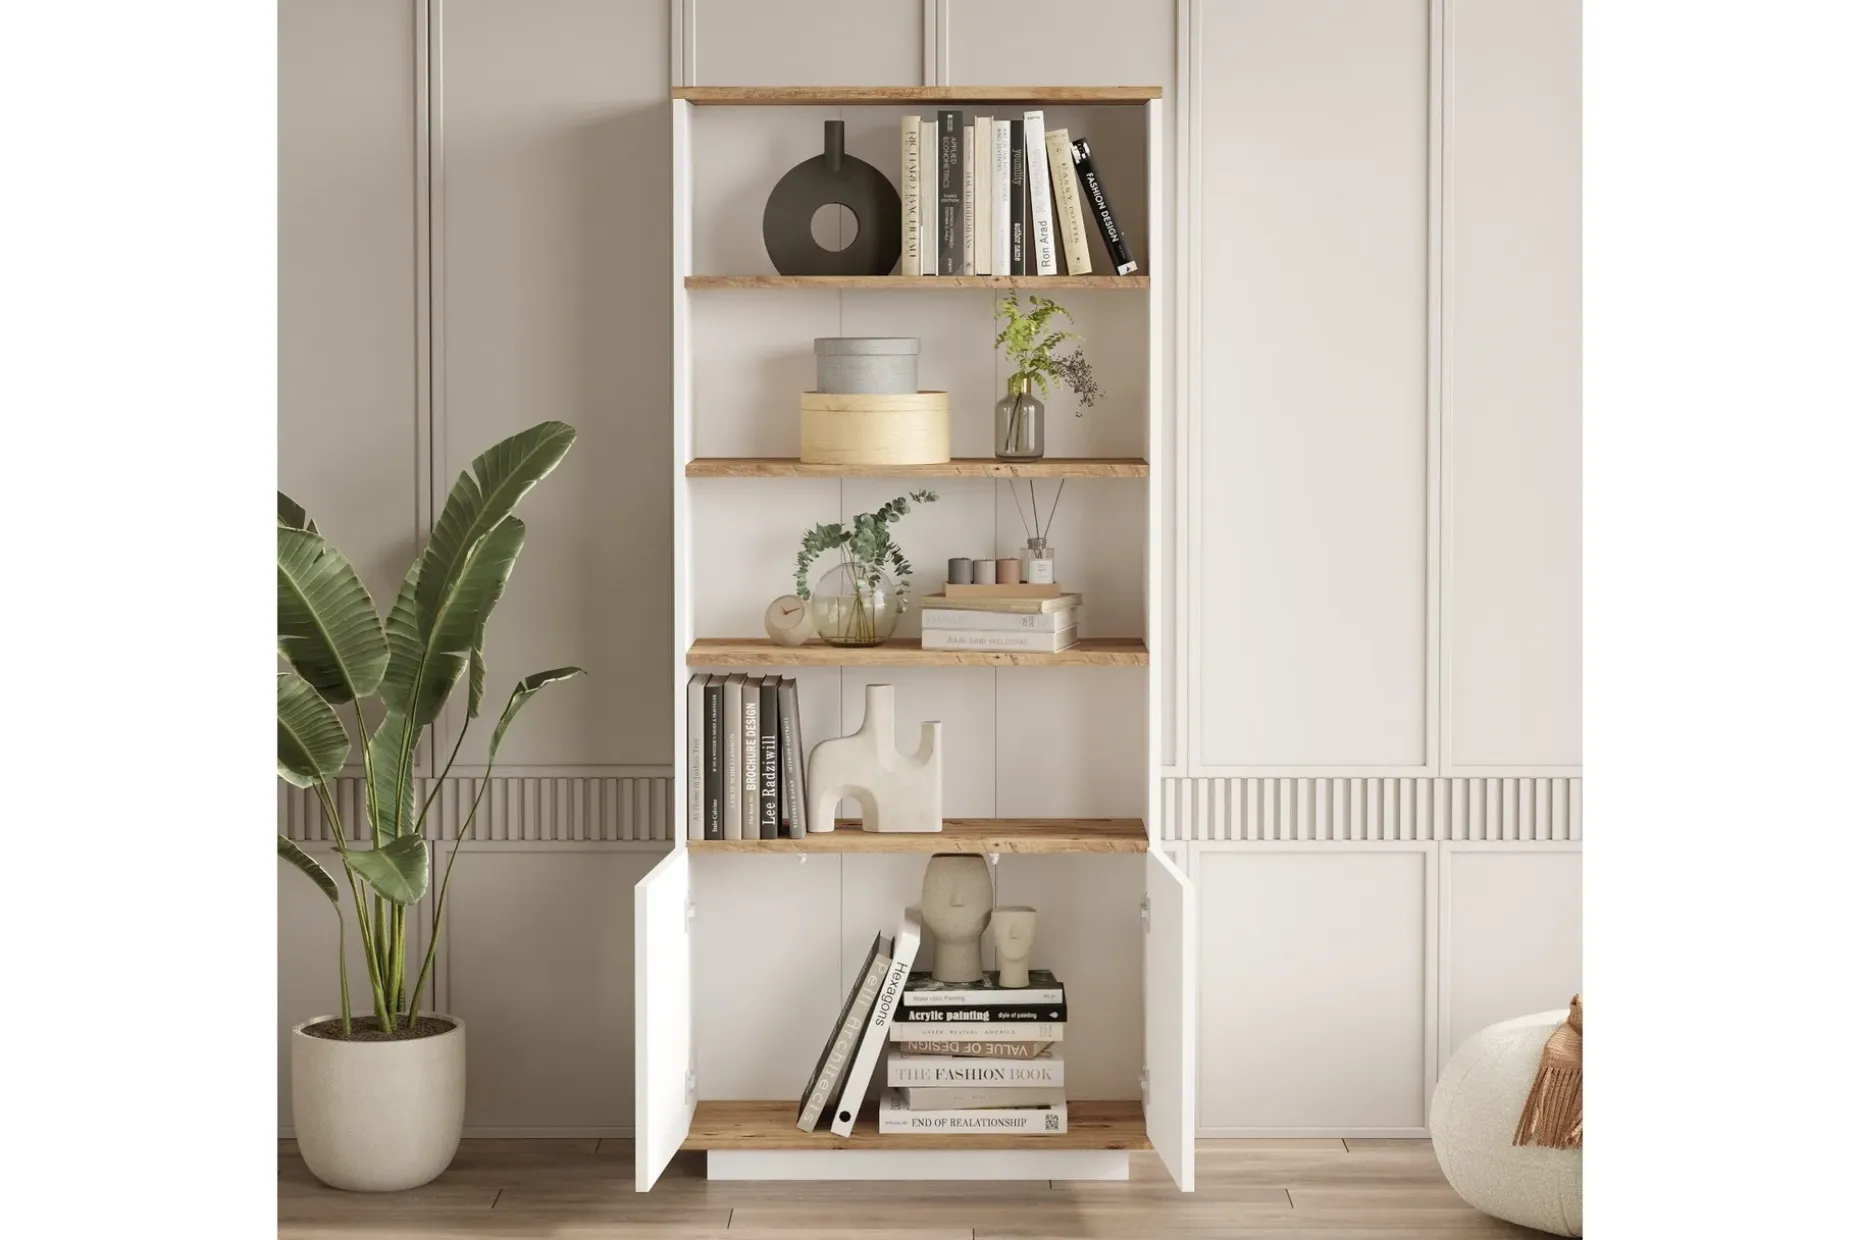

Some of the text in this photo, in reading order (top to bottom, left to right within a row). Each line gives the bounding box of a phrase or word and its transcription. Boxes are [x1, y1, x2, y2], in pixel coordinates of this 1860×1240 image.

[942, 136, 950, 189] ECONOMETRICS
[1086, 172, 1119, 243] FASHION DESIGN
[1013, 222, 1022, 262] author name
[1040, 220, 1051, 268] Ron Arad
[746, 702, 756, 791] BROCHURE DESIGN
[762, 735, 775, 825] Lee Radziwill
[860, 960, 888, 1009] Pelli
[875, 961, 908, 1027] Hexagons
[909, 1010, 990, 1021] Acrylic painting
[908, 1041, 1028, 1056] VALUE OF DESIGN
[896, 1068, 1052, 1081] THE FASHION BOOK
[911, 1118, 932, 1127] END
[934, 1118, 948, 1127] OF
[949, 1117, 1027, 1127] REALATIONSHIP
